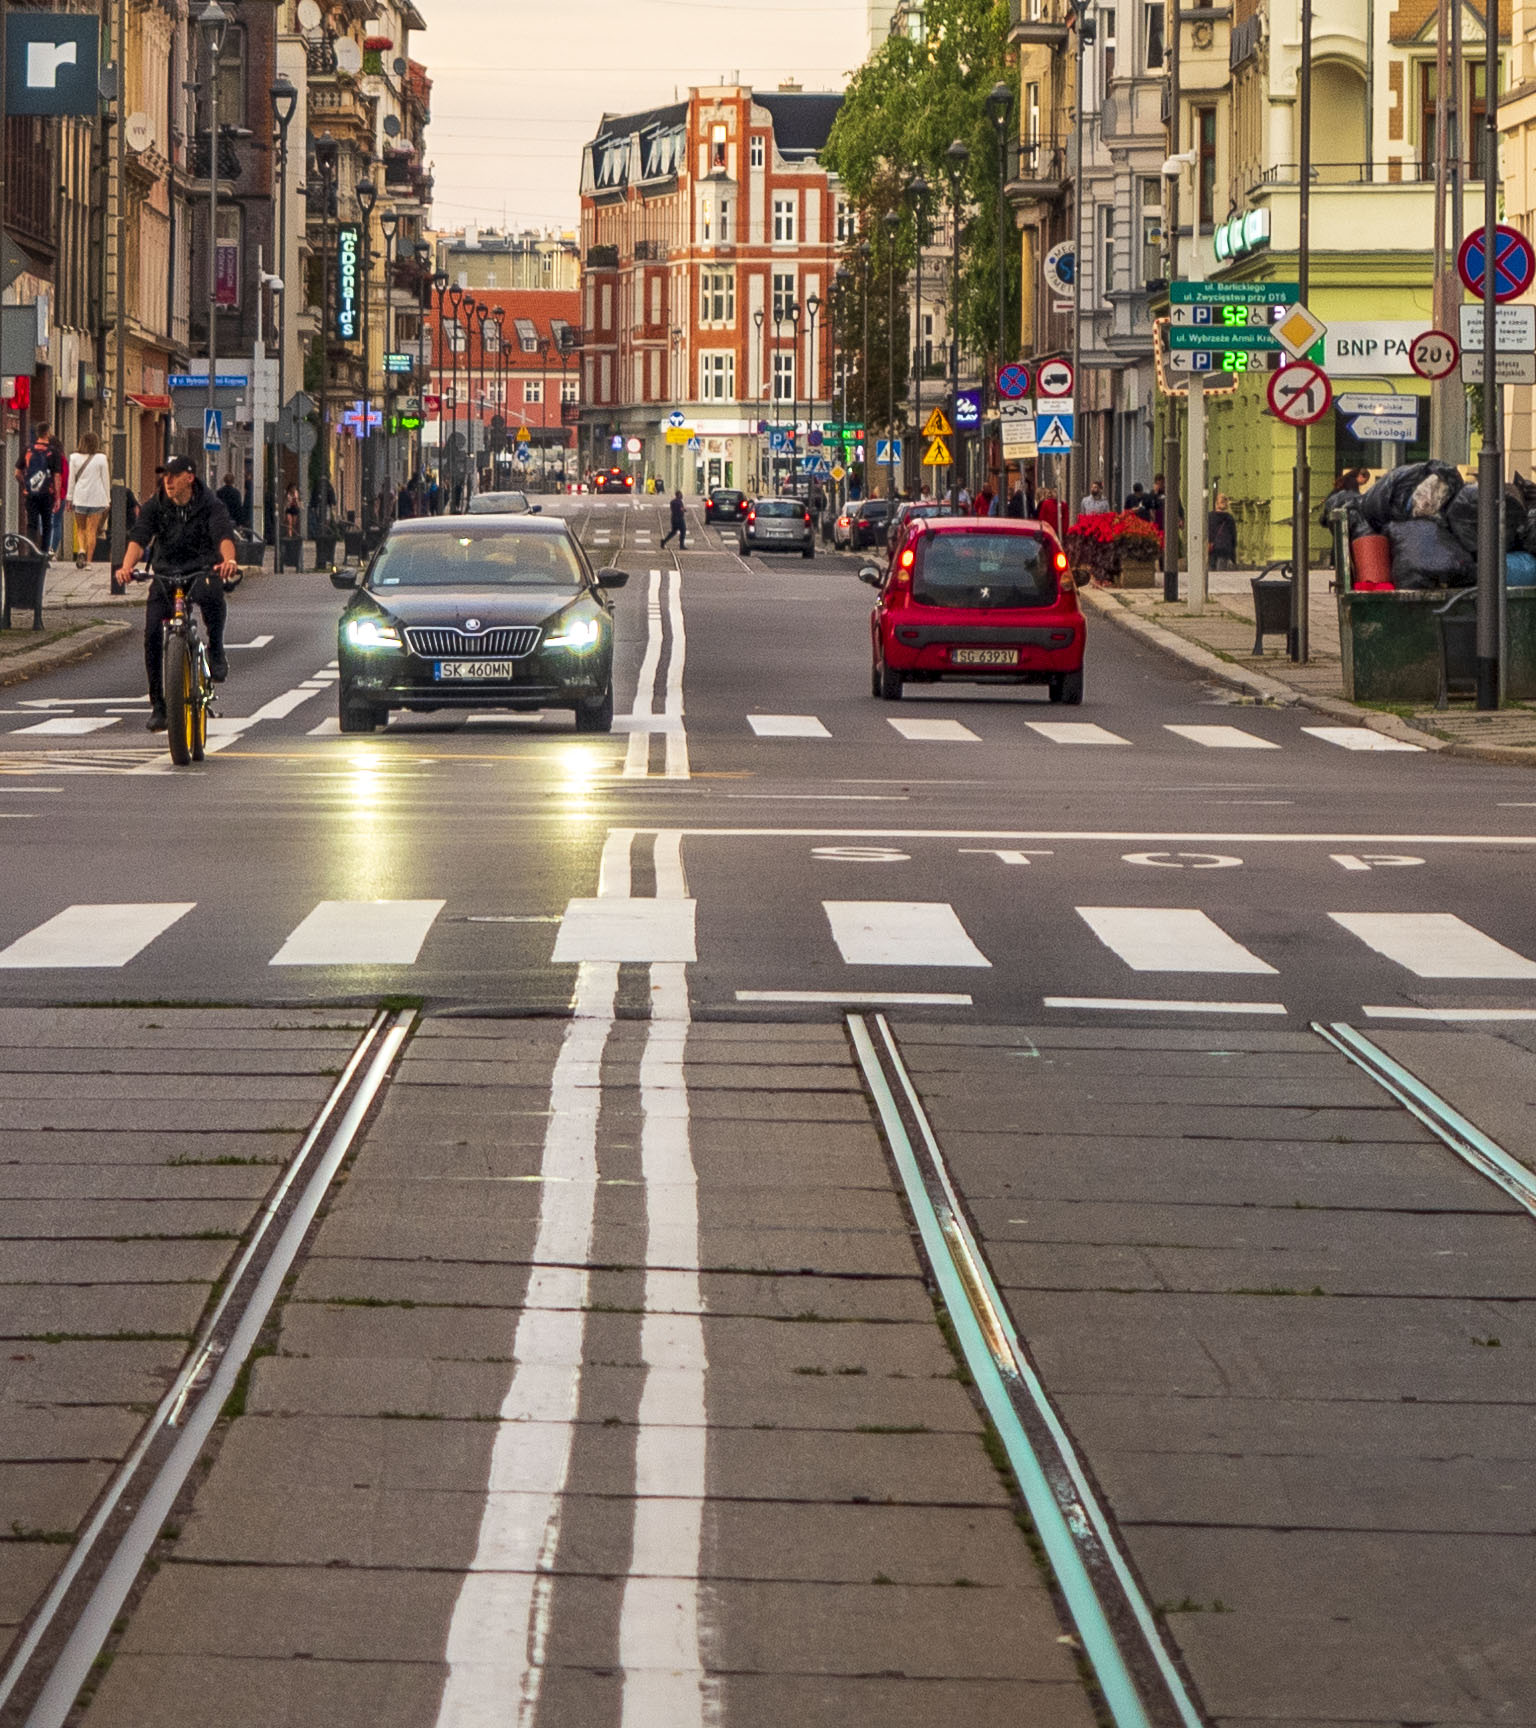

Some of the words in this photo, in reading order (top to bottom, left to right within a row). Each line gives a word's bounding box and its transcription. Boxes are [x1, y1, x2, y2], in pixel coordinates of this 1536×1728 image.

[1205, 284, 1215, 292] ul.
[1218, 283, 1266, 294] Barlickiego
[1184, 293, 1194, 301] ul.
[1196, 293, 1247, 303] Zwycięstwa
[1248, 295, 1266, 303] przy
[1176, 334, 1187, 343] ul.
[1189, 334, 1229, 345] Wybrzeże
[1232, 334, 1255, 343] Armii
[1337, 339, 1378, 357] BNP
[1223, 351, 1248, 372] 22
[959, 650, 975, 662] SG
[979, 650, 1015, 662] 6393V
[443, 663, 463, 677] SK
[468, 663, 510, 677] 460MN
